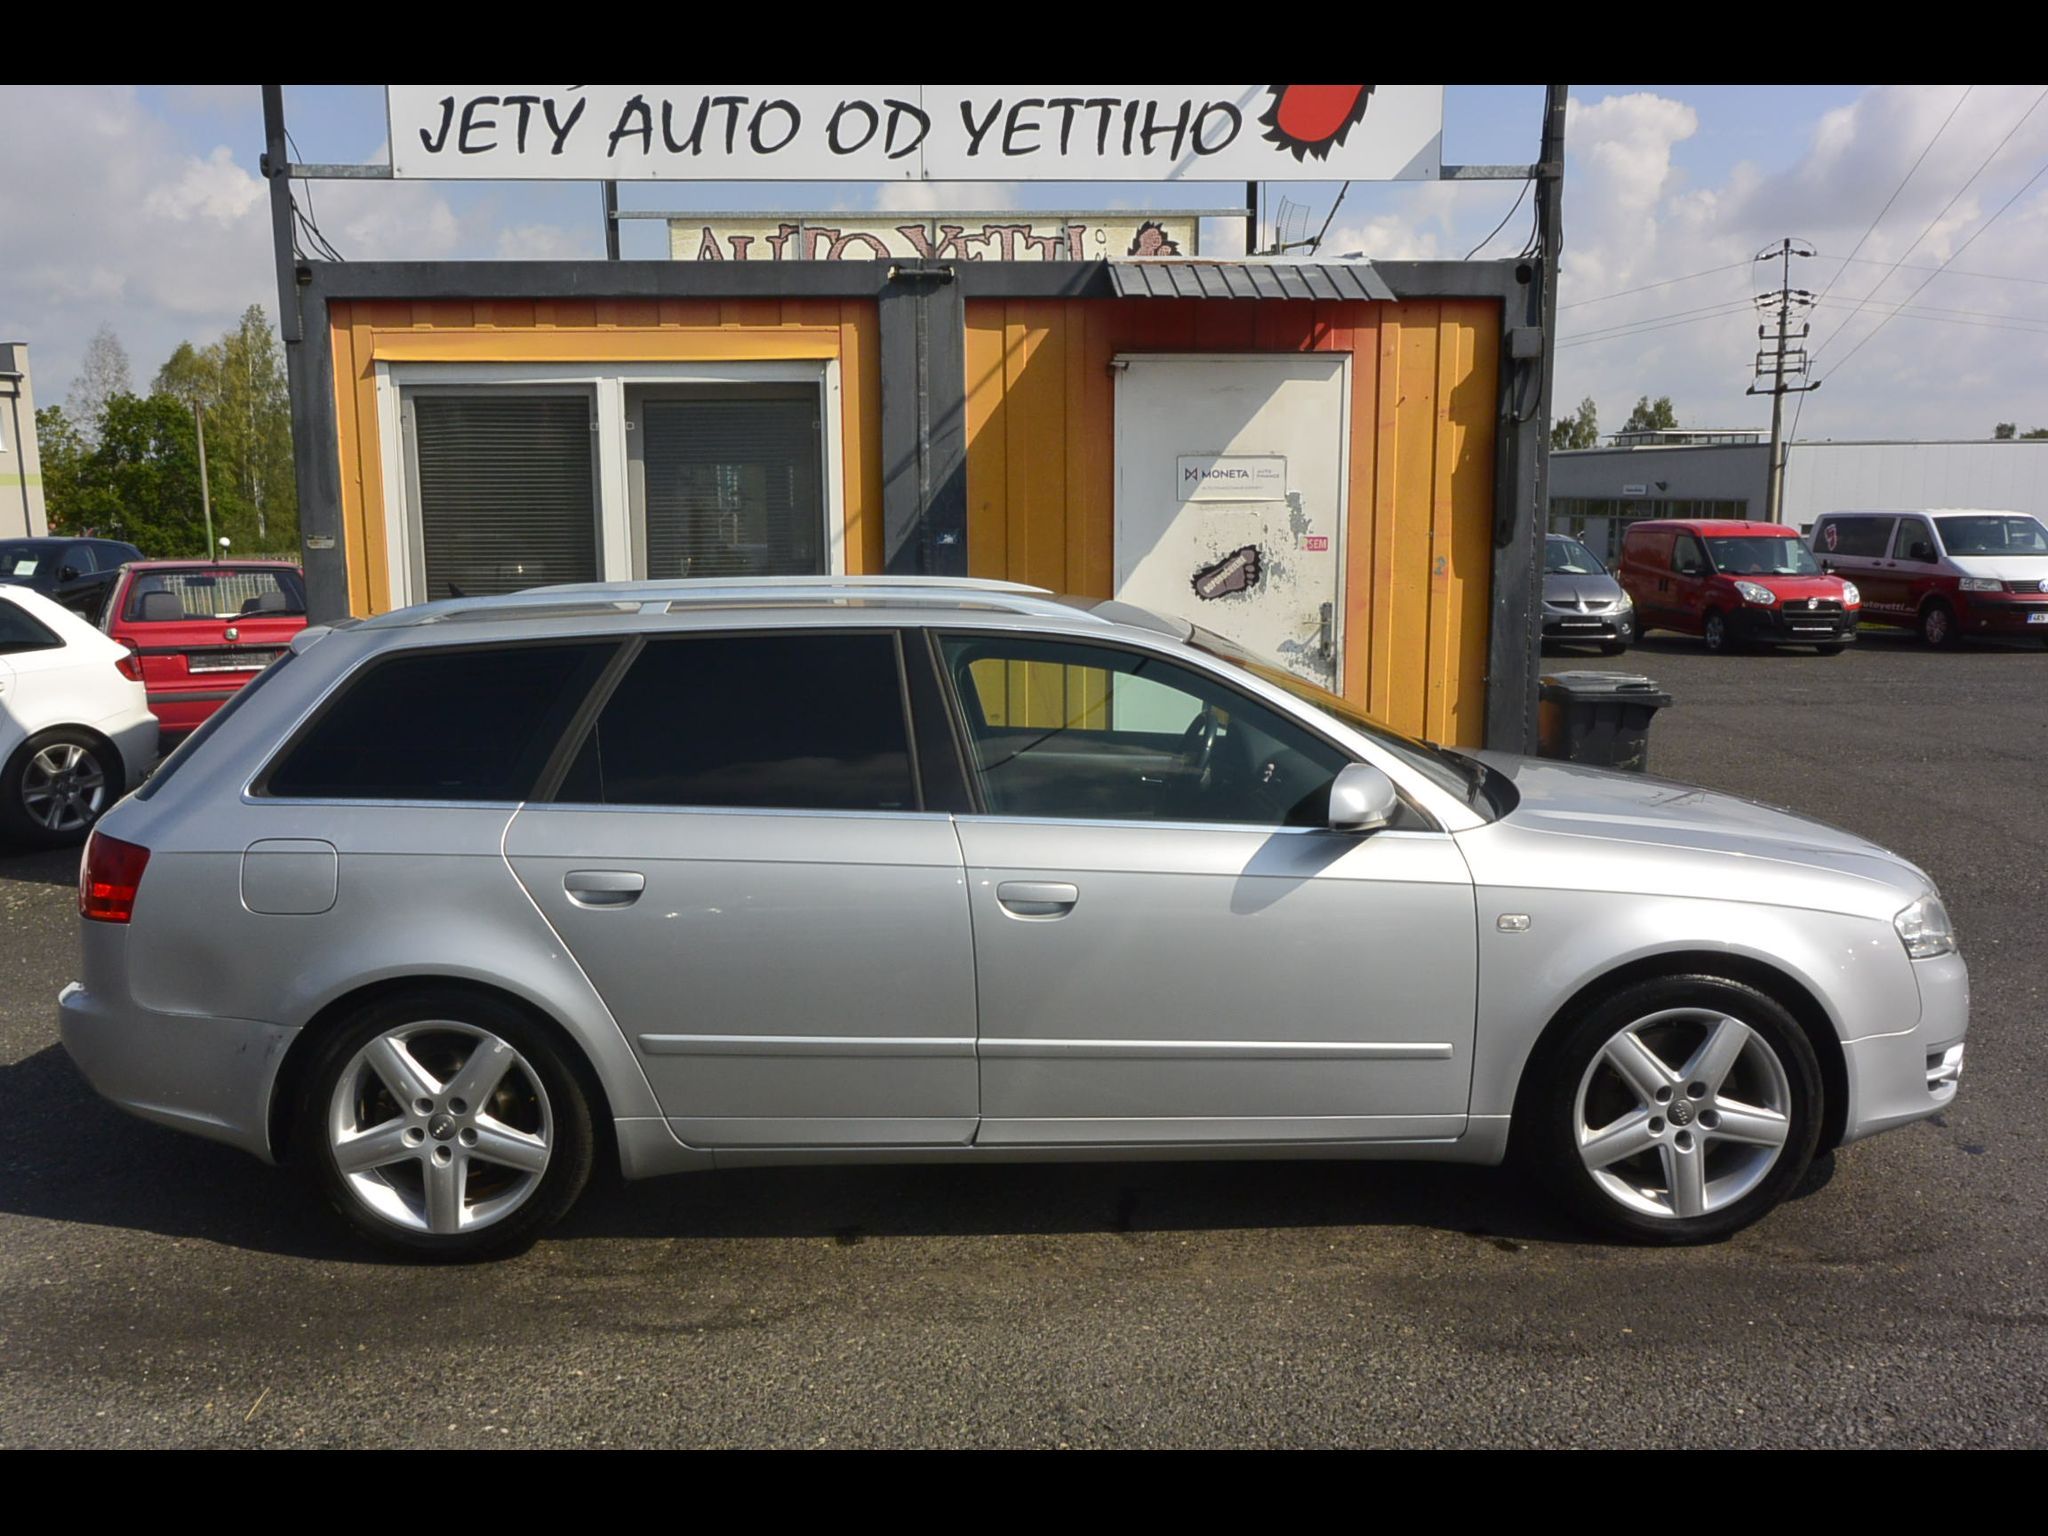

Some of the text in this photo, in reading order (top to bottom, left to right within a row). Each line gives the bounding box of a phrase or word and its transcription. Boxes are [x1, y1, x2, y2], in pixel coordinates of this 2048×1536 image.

[607, 93, 801, 158] AUTO
[826, 99, 931, 159] OD
[960, 98, 1243, 161] YETTIHO
[1201, 469, 1250, 479] MONETA
[1308, 538, 1327, 549] SEM
